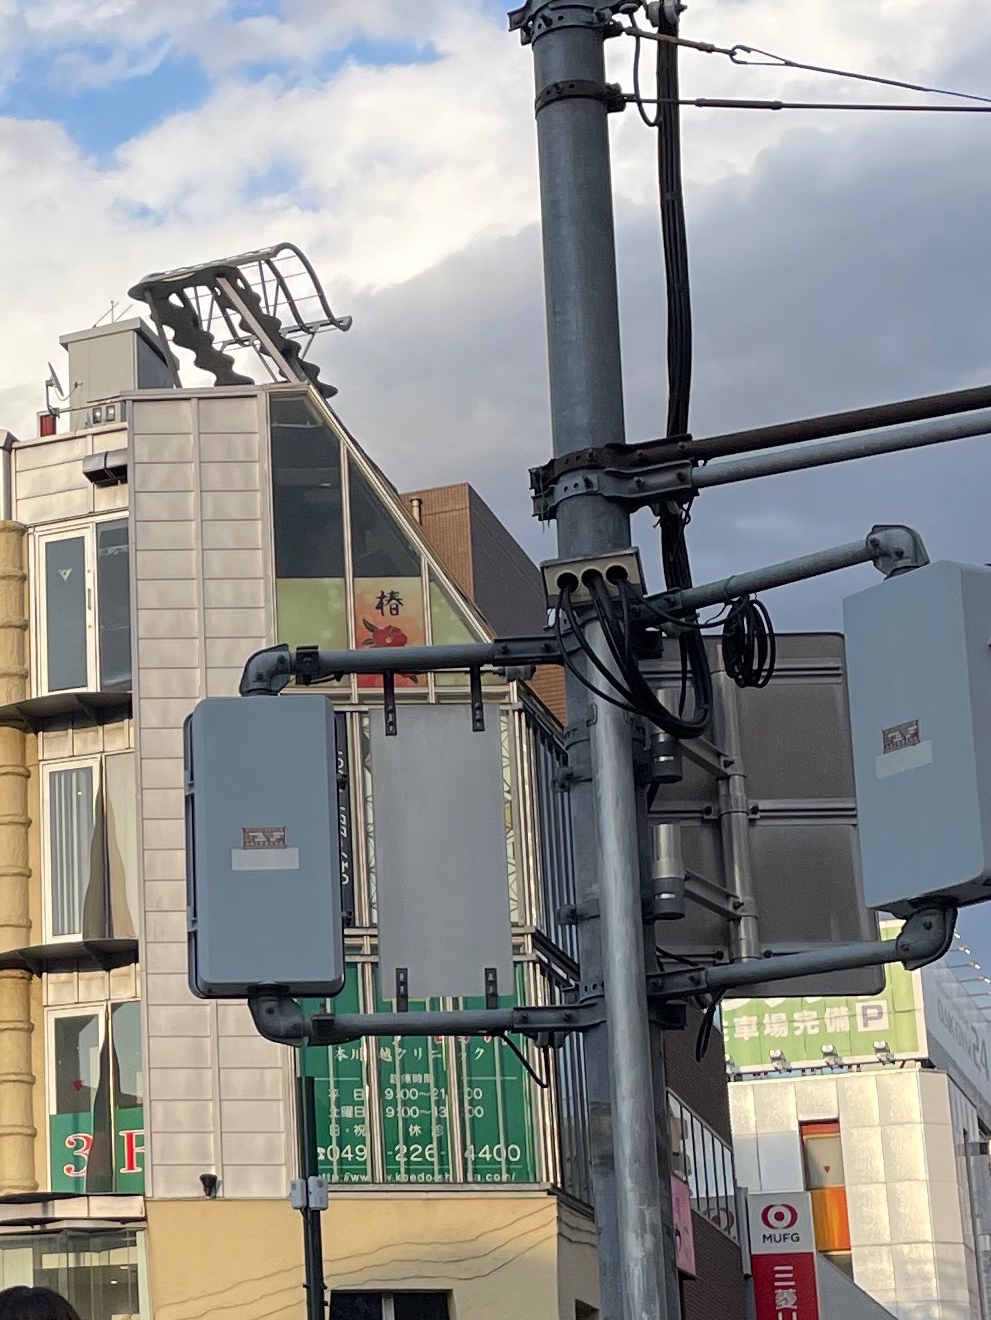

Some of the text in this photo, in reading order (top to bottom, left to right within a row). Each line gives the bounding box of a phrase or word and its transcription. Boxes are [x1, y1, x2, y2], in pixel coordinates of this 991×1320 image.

[375, 590, 404, 617] 椿
[723, 1004, 883, 1041] 車場完備 P
[762, 1232, 801, 1244] MUFG
